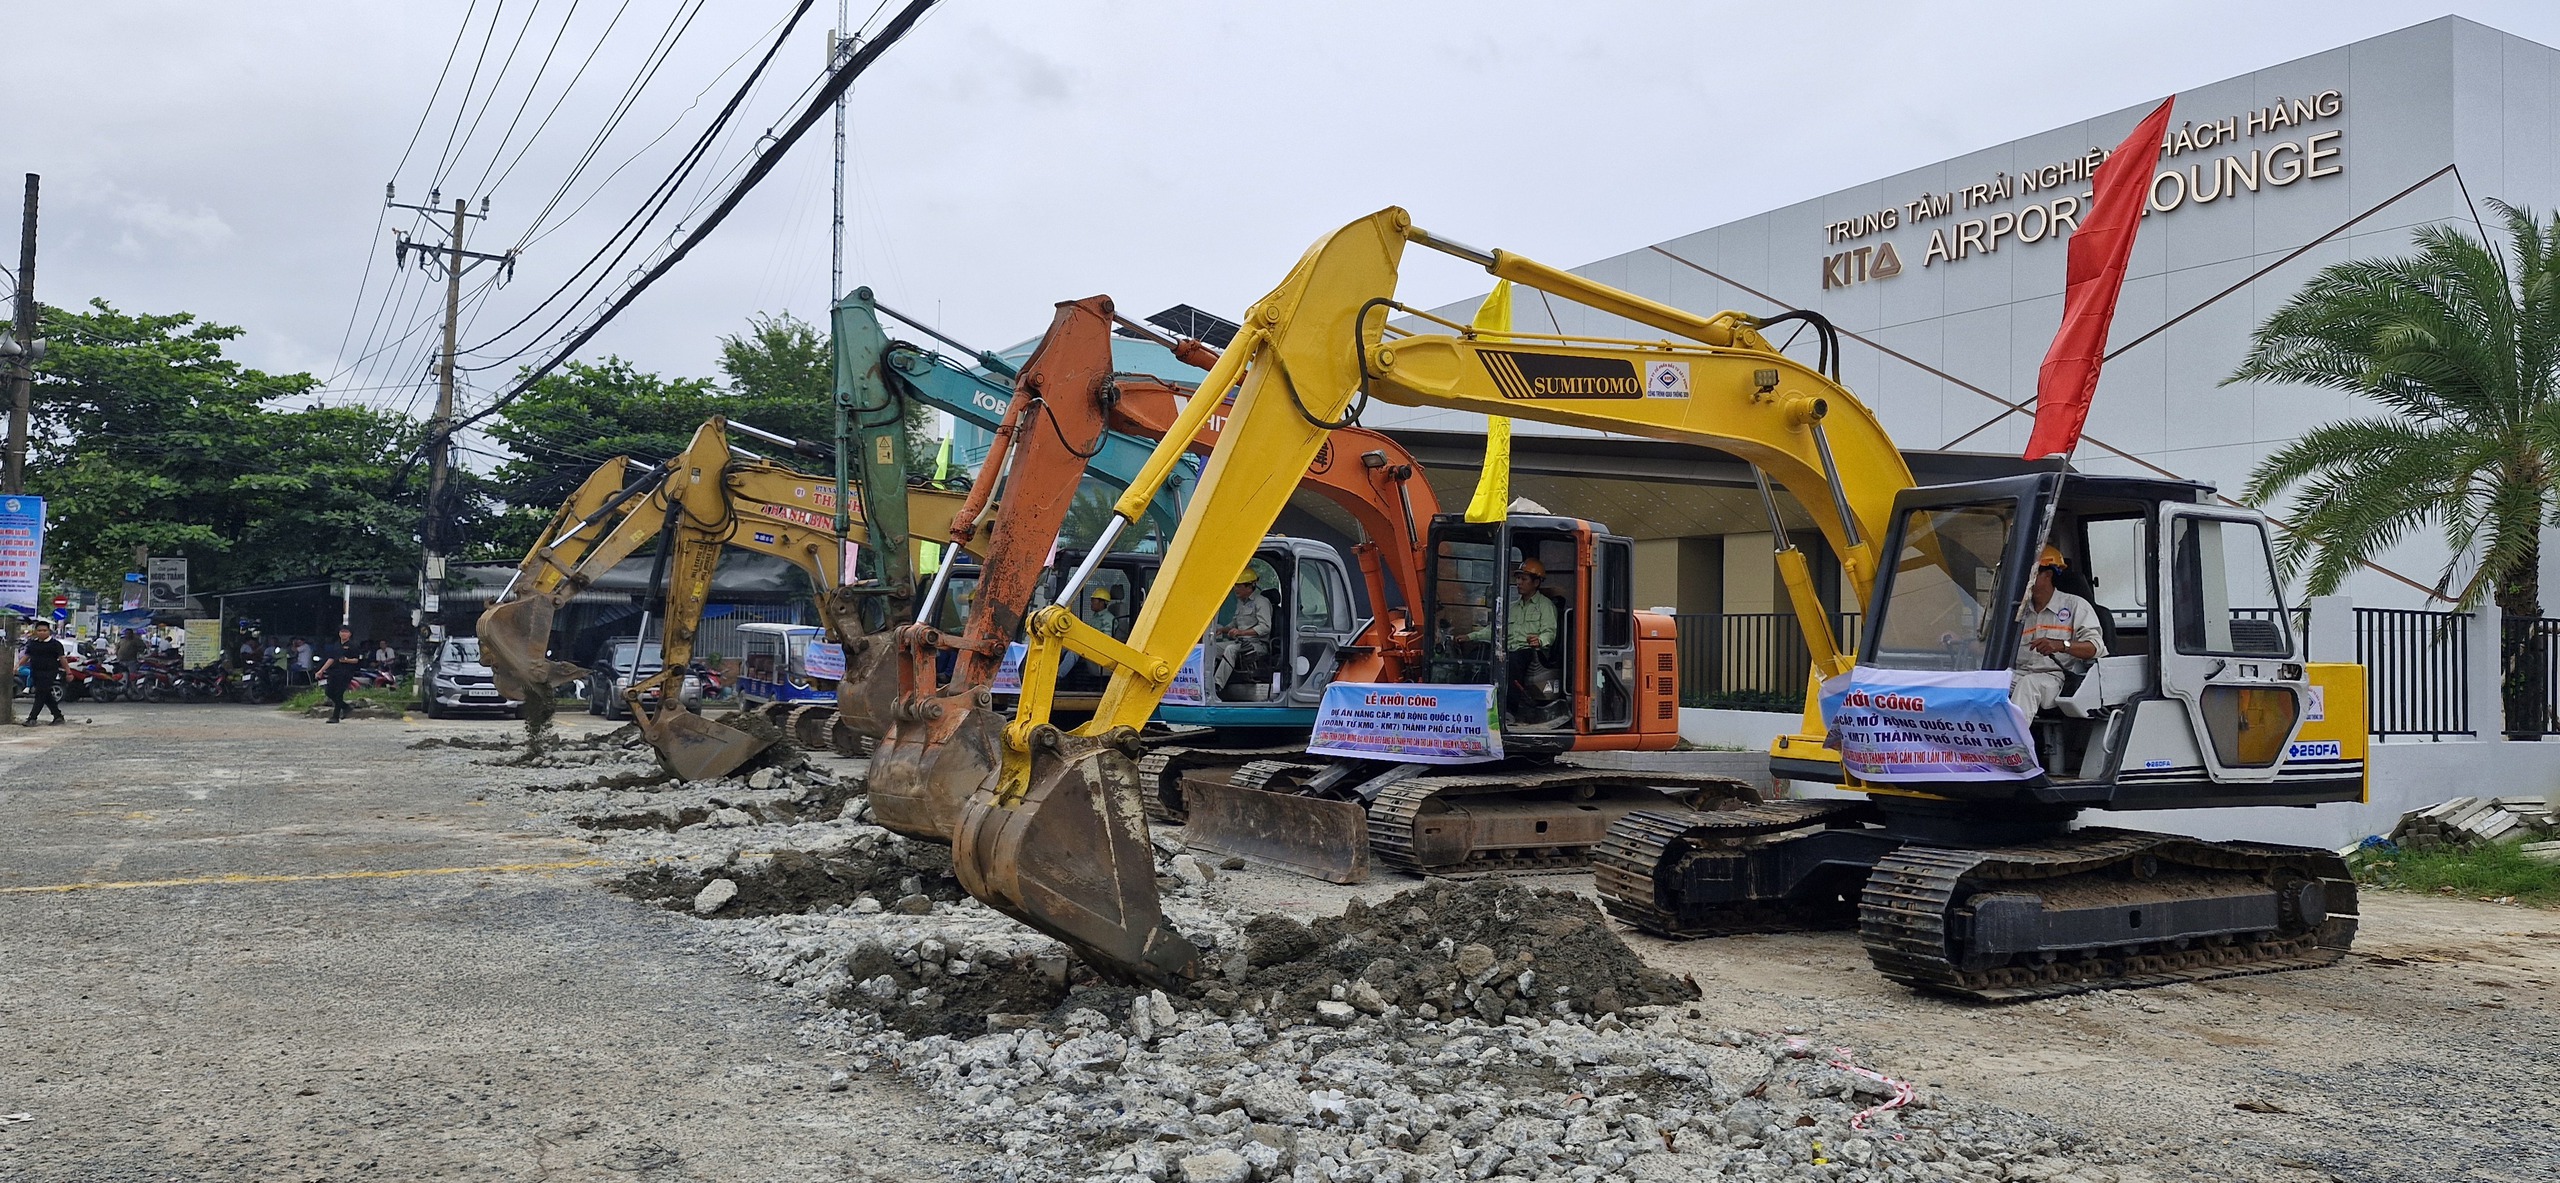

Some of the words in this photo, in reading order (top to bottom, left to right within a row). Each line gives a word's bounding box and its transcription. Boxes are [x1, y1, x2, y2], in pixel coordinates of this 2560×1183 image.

[1824, 208, 1898, 244] TRUNG
[1904, 192, 1952, 223] TÂM
[1959, 171, 2013, 209] TRẢI
[2158, 121, 2238, 161] HÁCH
[2247, 90, 2342, 136] HÀNG
[2142, 130, 2343, 216] OUNGE
[1534, 376, 1639, 395] SUMITOMO
[1380, 692, 1404, 706] KHỞI
[1408, 694, 1437, 707] CÔNG
[1874, 693, 1924, 712] CÔNG
[1330, 708, 1340, 718] DỰ
[1341, 708, 1352, 717] ÁN
[1354, 709, 1374, 718] NÂNG
[1394, 710, 1405, 719] MỞ
[1408, 712, 1427, 722] RỘNG
[1430, 712, 1450, 722] QUỐC
[1452, 713, 1461, 723] LỘ
[1856, 712, 1879, 727] MỞ
[1884, 715, 1918, 729] RỘNG
[1919, 718, 1954, 731] QUỐC
[1957, 721, 1976, 734] LỘ
[1978, 722, 1994, 734] 91
[1381, 722, 1399, 730] KM7)
[1402, 723, 1426, 732] THÀNH
[1428, 724, 1443, 733] PHỐ
[1445, 724, 1462, 734] CẦN
[1464, 726, 1481, 734] THƠ
[1874, 730, 1922, 742] THÀNH
[1924, 733, 1951, 744] PHỐ
[1953, 734, 1982, 747] CẦN
[1984, 737, 2014, 748] THƠ
[1914, 750, 1926, 763] THƠ
[2004, 753, 2023, 766] 2030
[2300, 744, 2338, 758] 260FA
